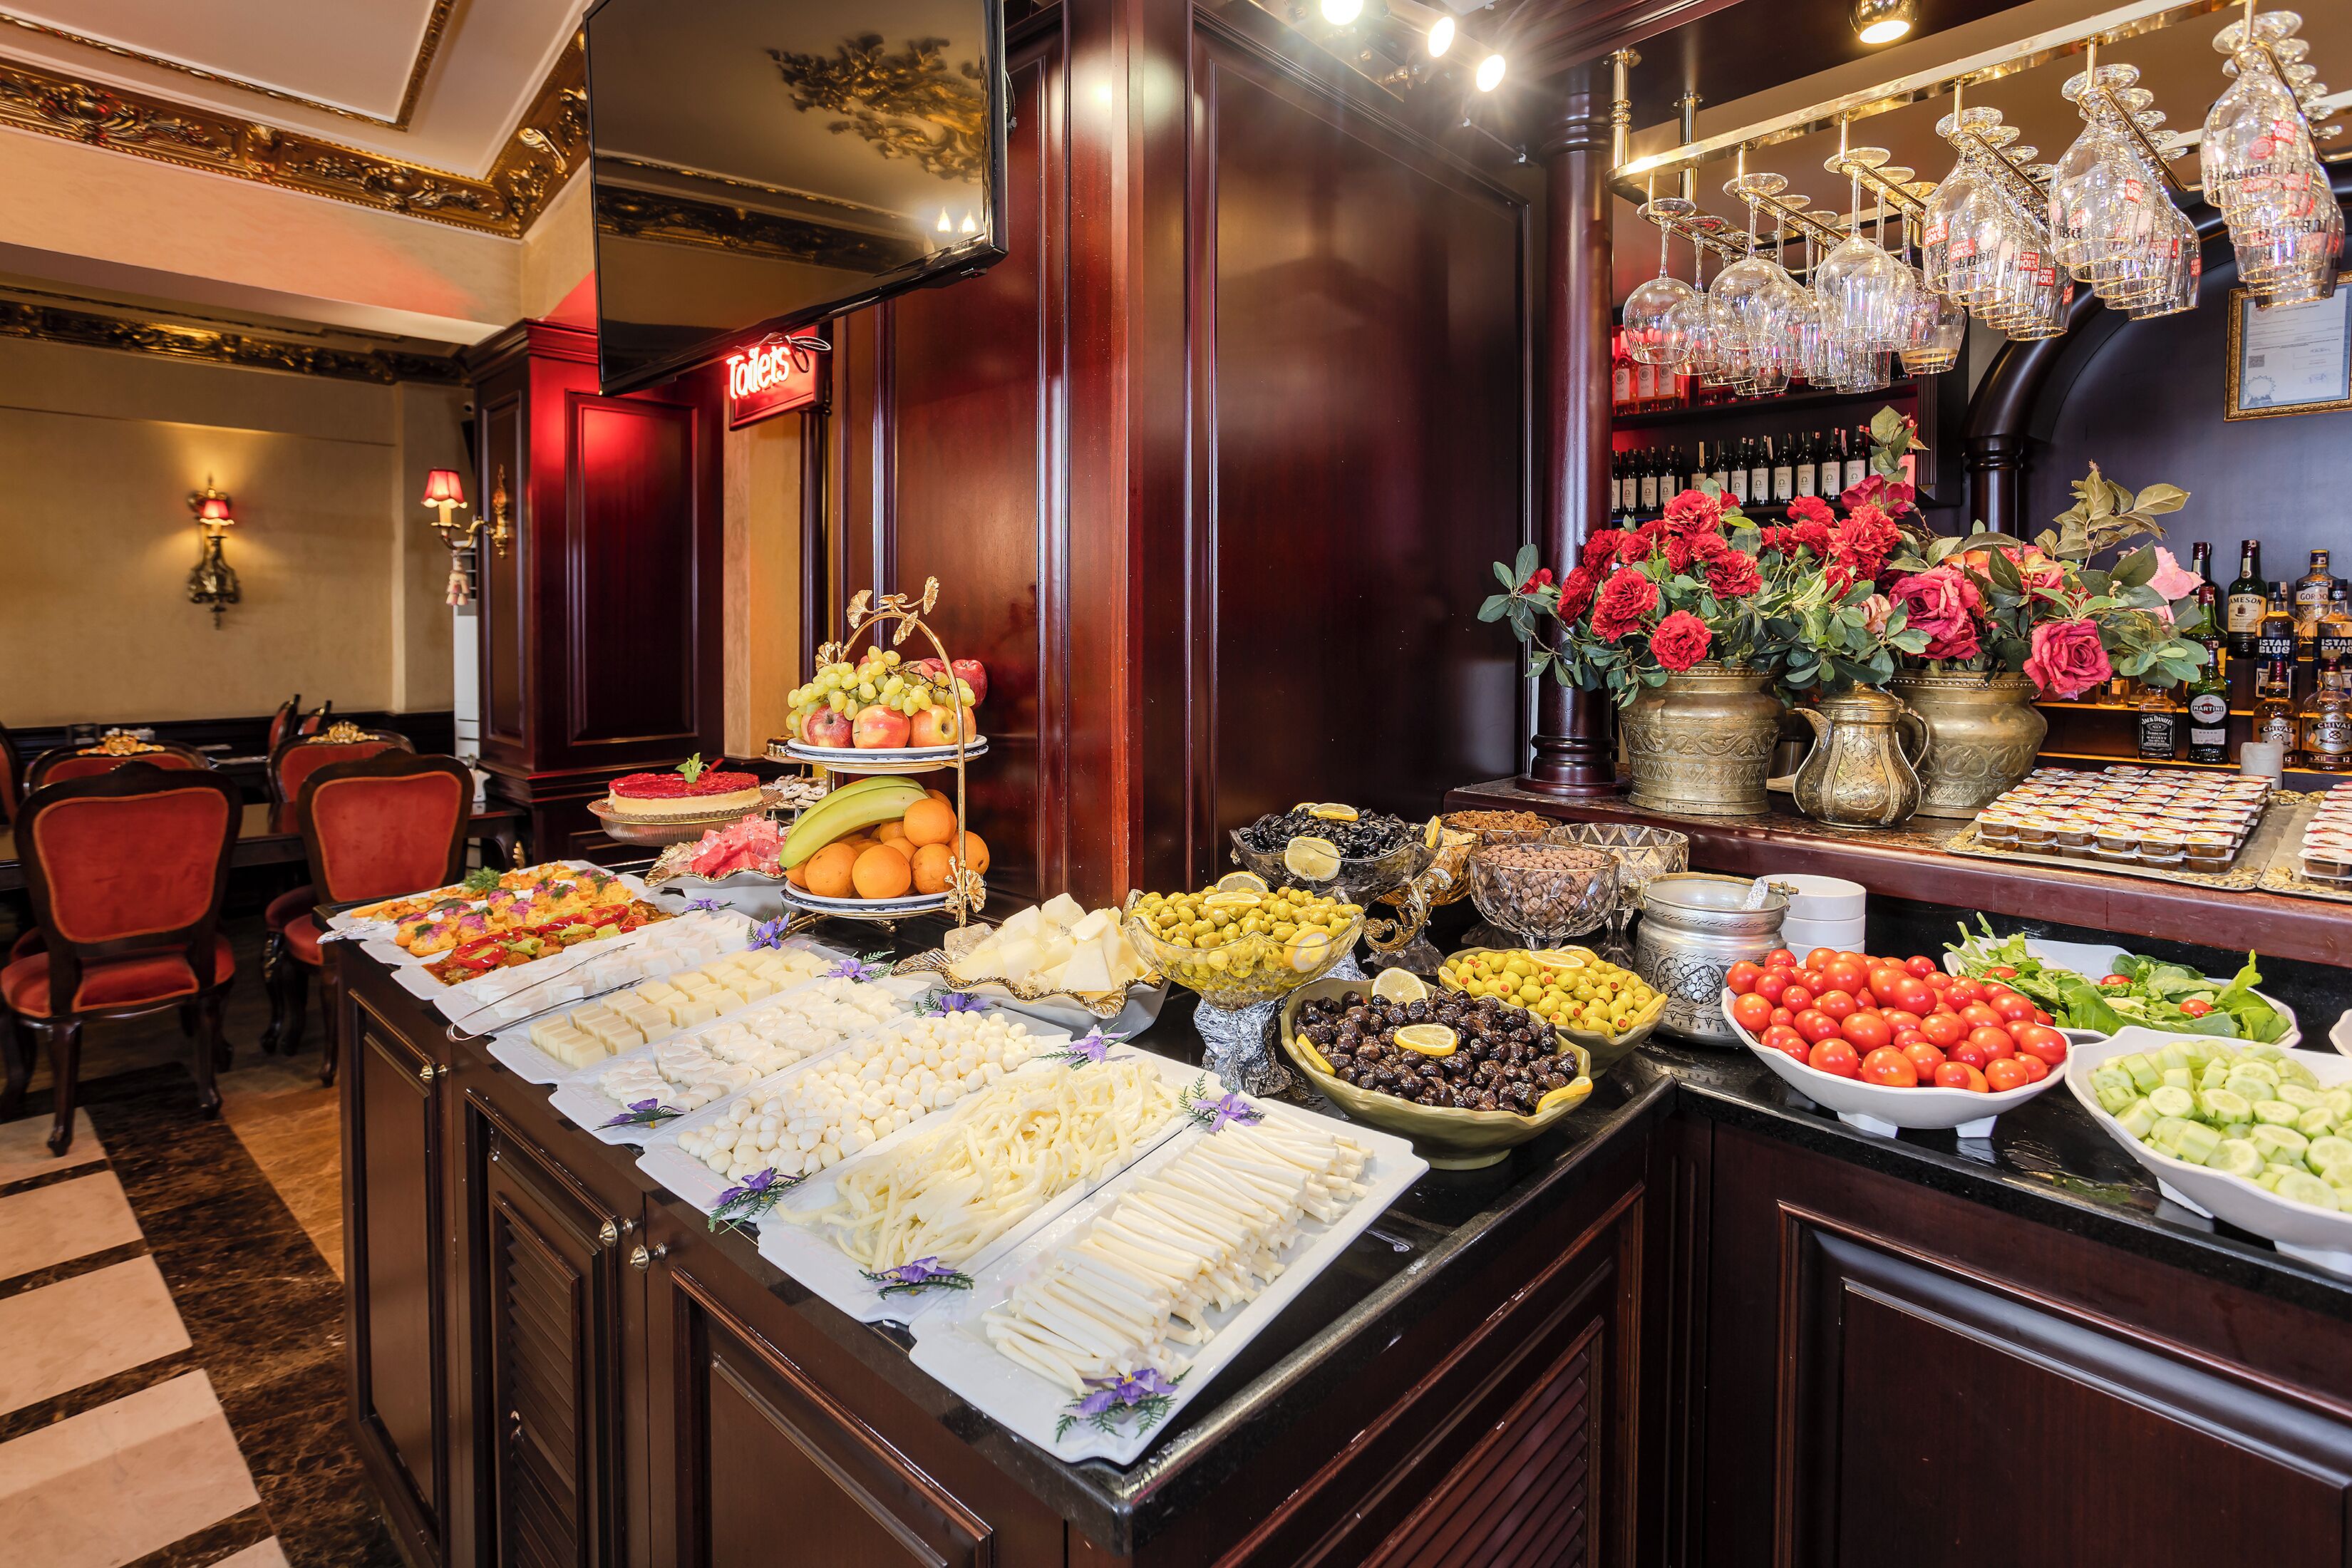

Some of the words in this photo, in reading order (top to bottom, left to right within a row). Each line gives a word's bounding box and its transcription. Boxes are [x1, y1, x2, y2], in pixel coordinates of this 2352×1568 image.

[1951, 247, 1973, 259] %100
[2038, 275, 2053, 284] %10
[726, 346, 791, 399] Toilets
